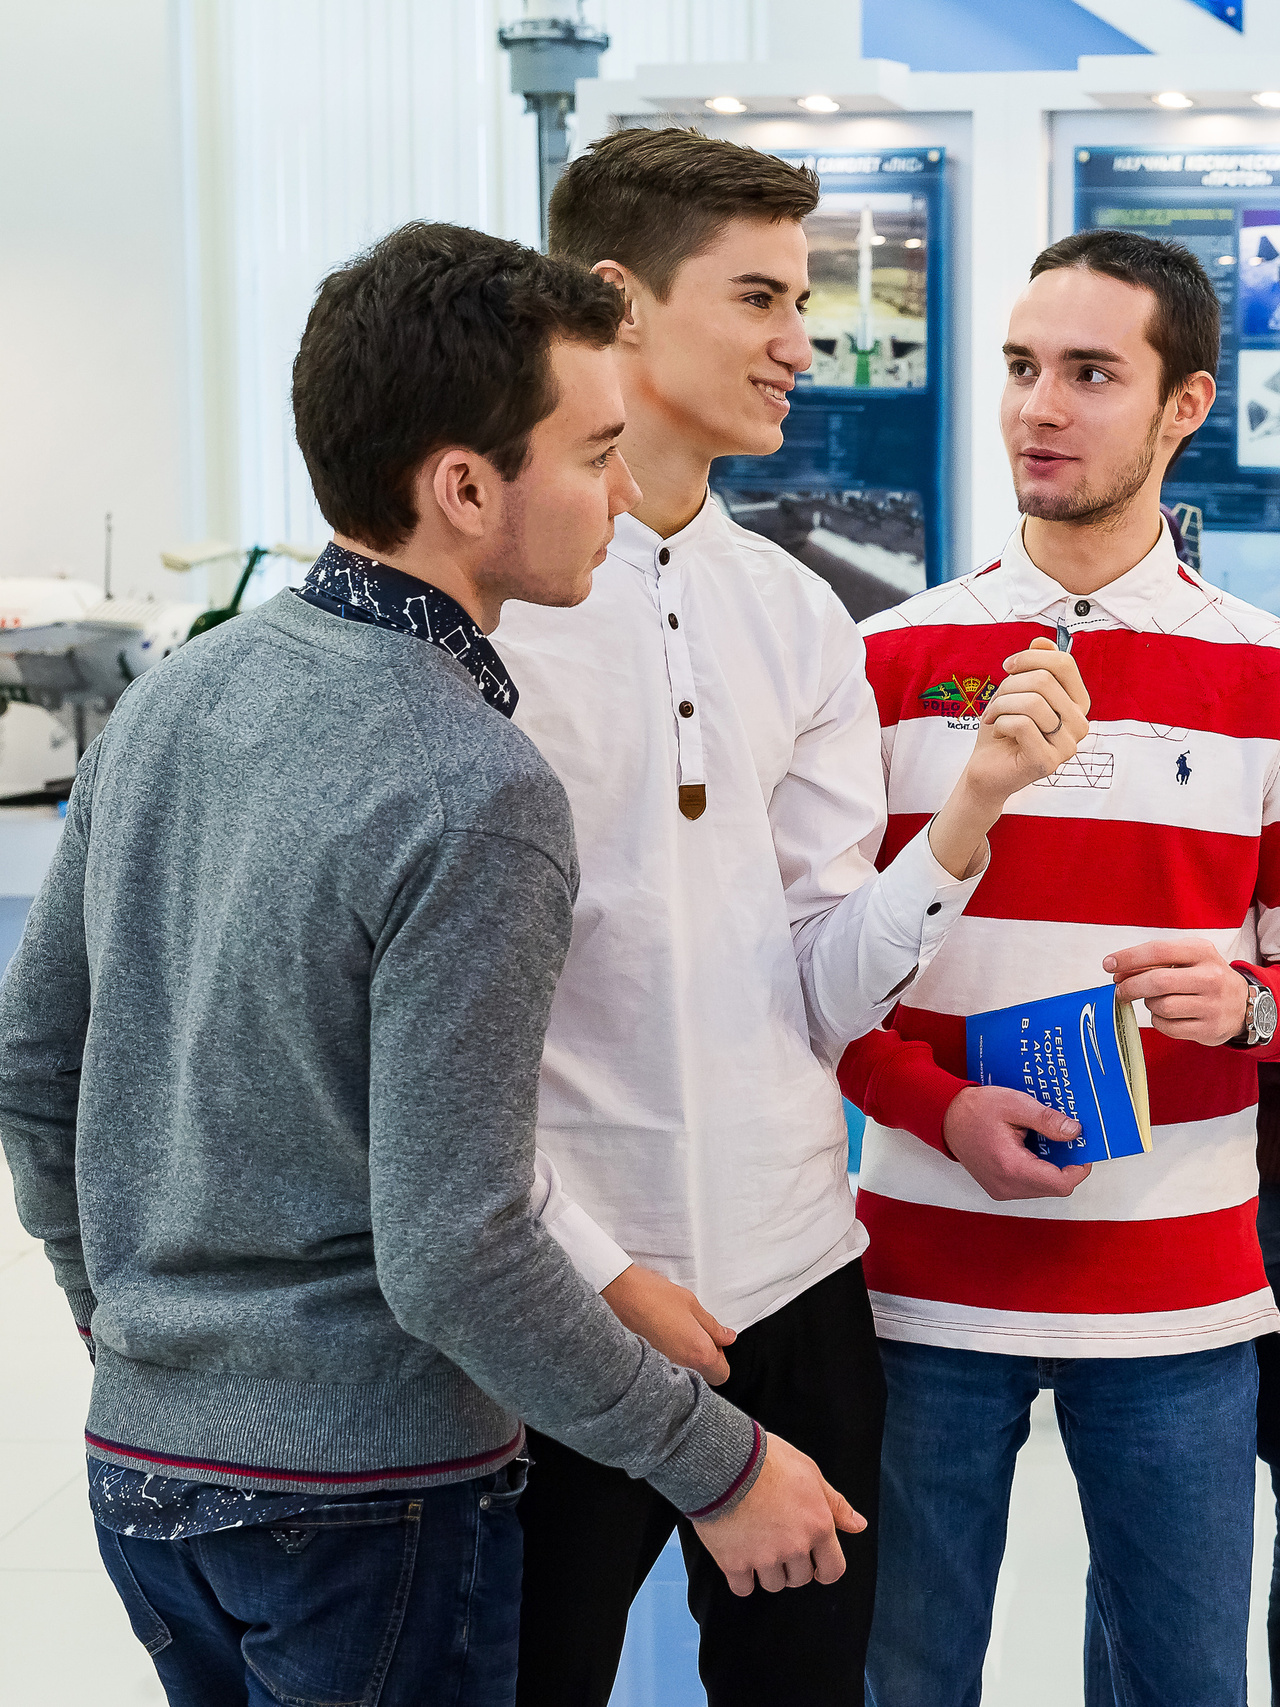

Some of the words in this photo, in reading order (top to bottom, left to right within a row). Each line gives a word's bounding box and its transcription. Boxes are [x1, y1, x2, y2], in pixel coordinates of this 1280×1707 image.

[923, 700, 960, 710] POLO
[1020, 1017, 1030, 1034] В.
[1020, 1039, 1029, 1056] Н.
[1032, 1040, 1053, 1109] АКАДЕМ
[1043, 1029, 1073, 1150] КОНСТРУКР
[1054, 1026, 1087, 1148] ГЕНЕРАЛЬНЙ
